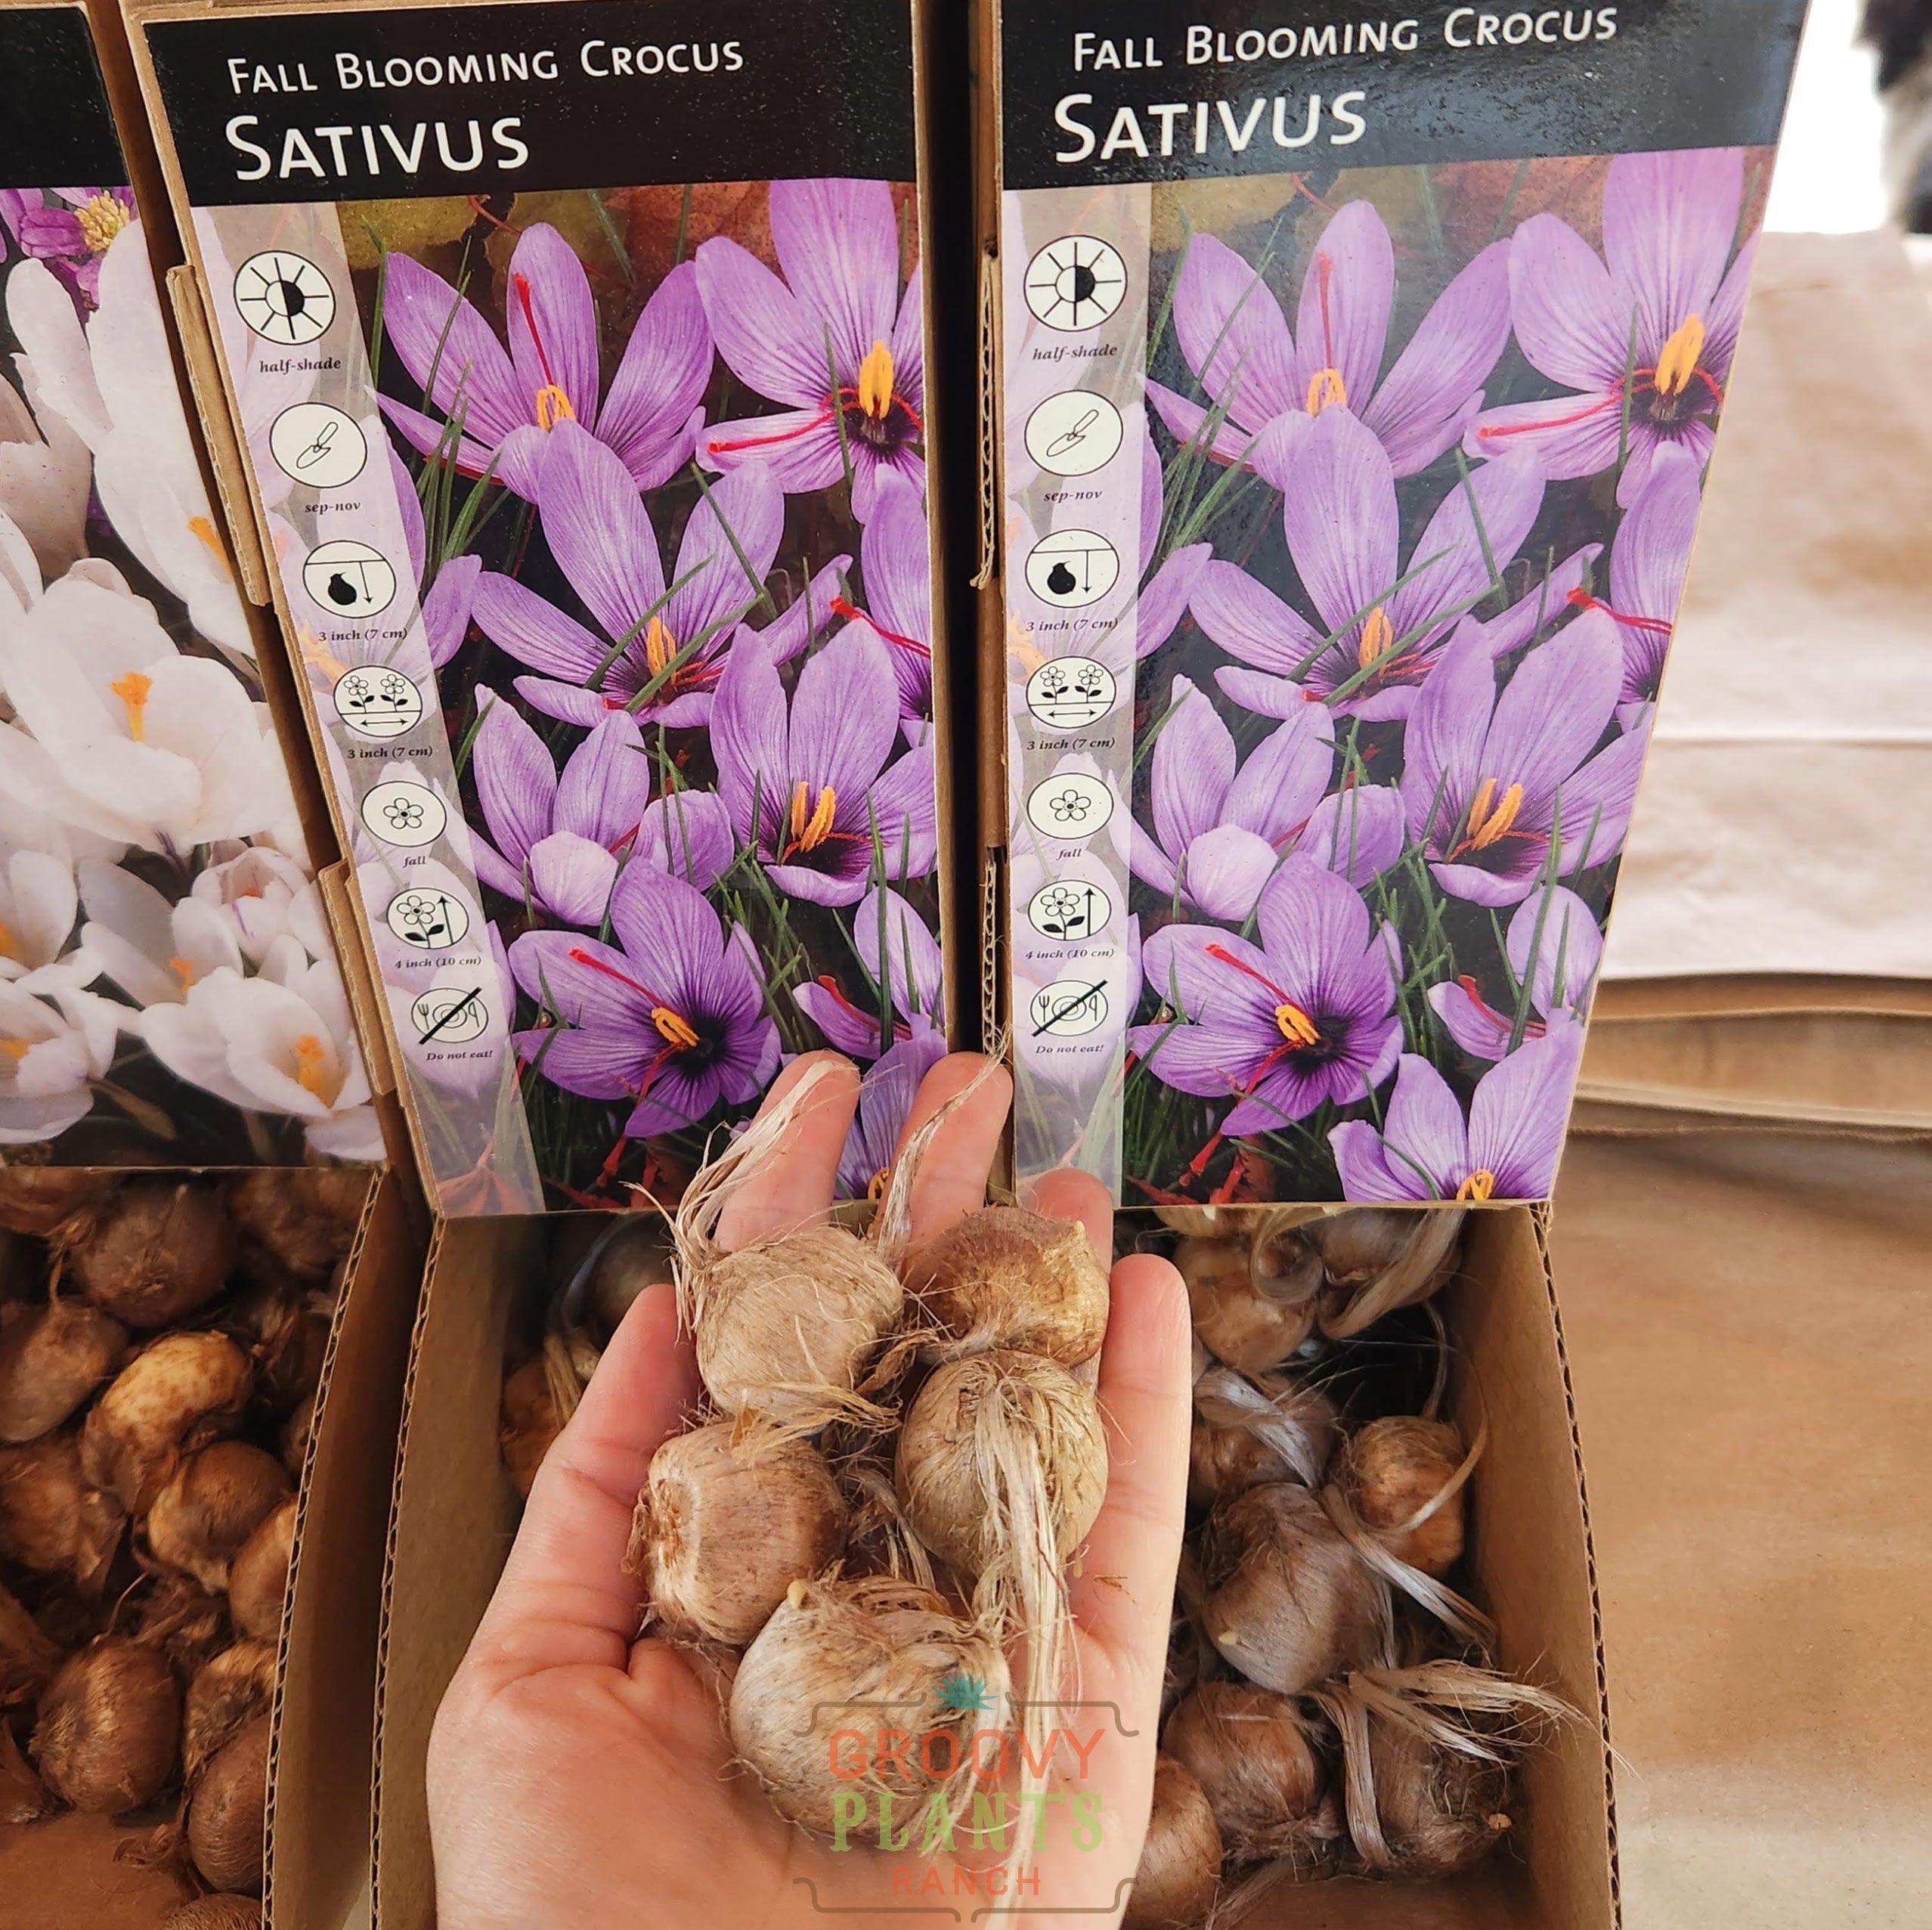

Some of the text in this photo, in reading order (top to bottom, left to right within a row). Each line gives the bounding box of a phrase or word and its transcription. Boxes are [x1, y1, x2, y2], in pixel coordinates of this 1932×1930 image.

[1074, 6, 1618, 72] FALL BLOOMING CROCUS
[228, 39, 744, 94] FALL BLOOMING CROCUS
[1054, 91, 1367, 164] SATIVUS
[225, 114, 529, 182] SATIVUS
[1032, 343, 1118, 363] half-shade
[259, 357, 342, 373] half-shade
[1043, 490, 1103, 503] sep-nov
[305, 500, 361, 516] sep-nov
[1026, 617, 1119, 632] 3 inch (7 cm)
[318, 627, 408, 642] 3 inch (7 cm)
[1026, 737, 1116, 751] 3 inch (7 cm)
[348, 746, 433, 759] 3 inch (7 cm)
[1056, 848, 1082, 860] fall
[402, 856, 426, 869] fall
[1025, 948, 1114, 959] 4 inch (10 cm)
[395, 956, 482, 969] 4 inch (10 cm)
[426, 1049, 494, 1061] Do not eat!
[1036, 1044, 1104, 1054] Do not eat!
